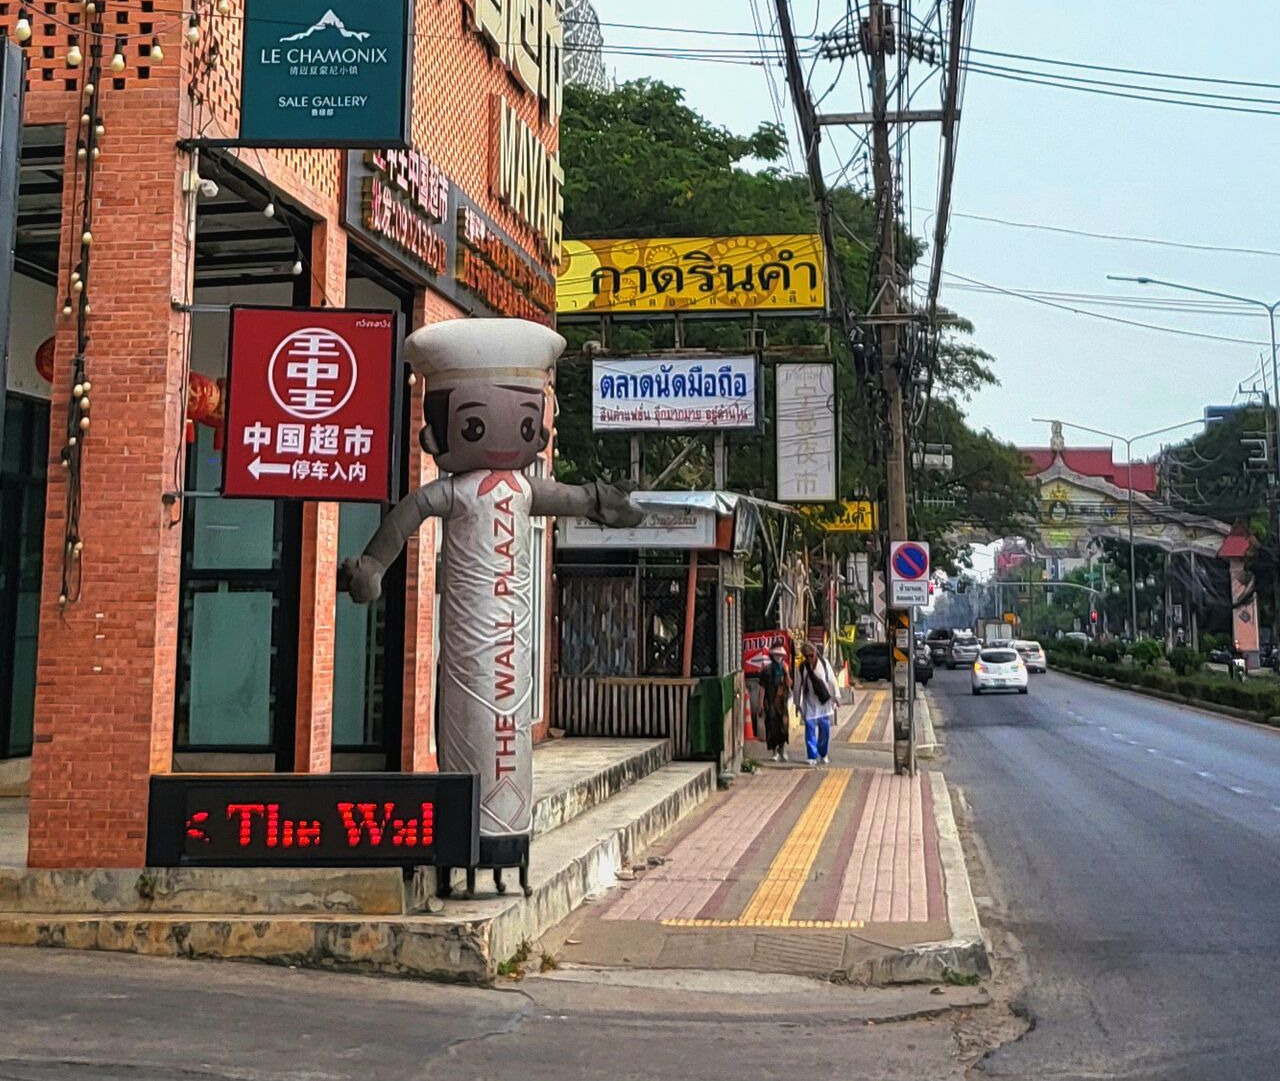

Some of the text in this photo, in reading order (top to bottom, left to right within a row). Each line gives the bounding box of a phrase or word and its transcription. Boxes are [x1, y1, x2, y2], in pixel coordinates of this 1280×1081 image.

[261, 47, 388, 64] LE CHAMONIX
[278, 95, 368, 108] SALE GALLERY
[591, 249, 817, 295] กาดรินคำ
[599, 363, 748, 399] ตลาดนัดมือถือ
[242, 420, 374, 457] 中国超市
[291, 459, 368, 482] 停车入内
[493, 495, 518, 781] THE WALL PLAZA
